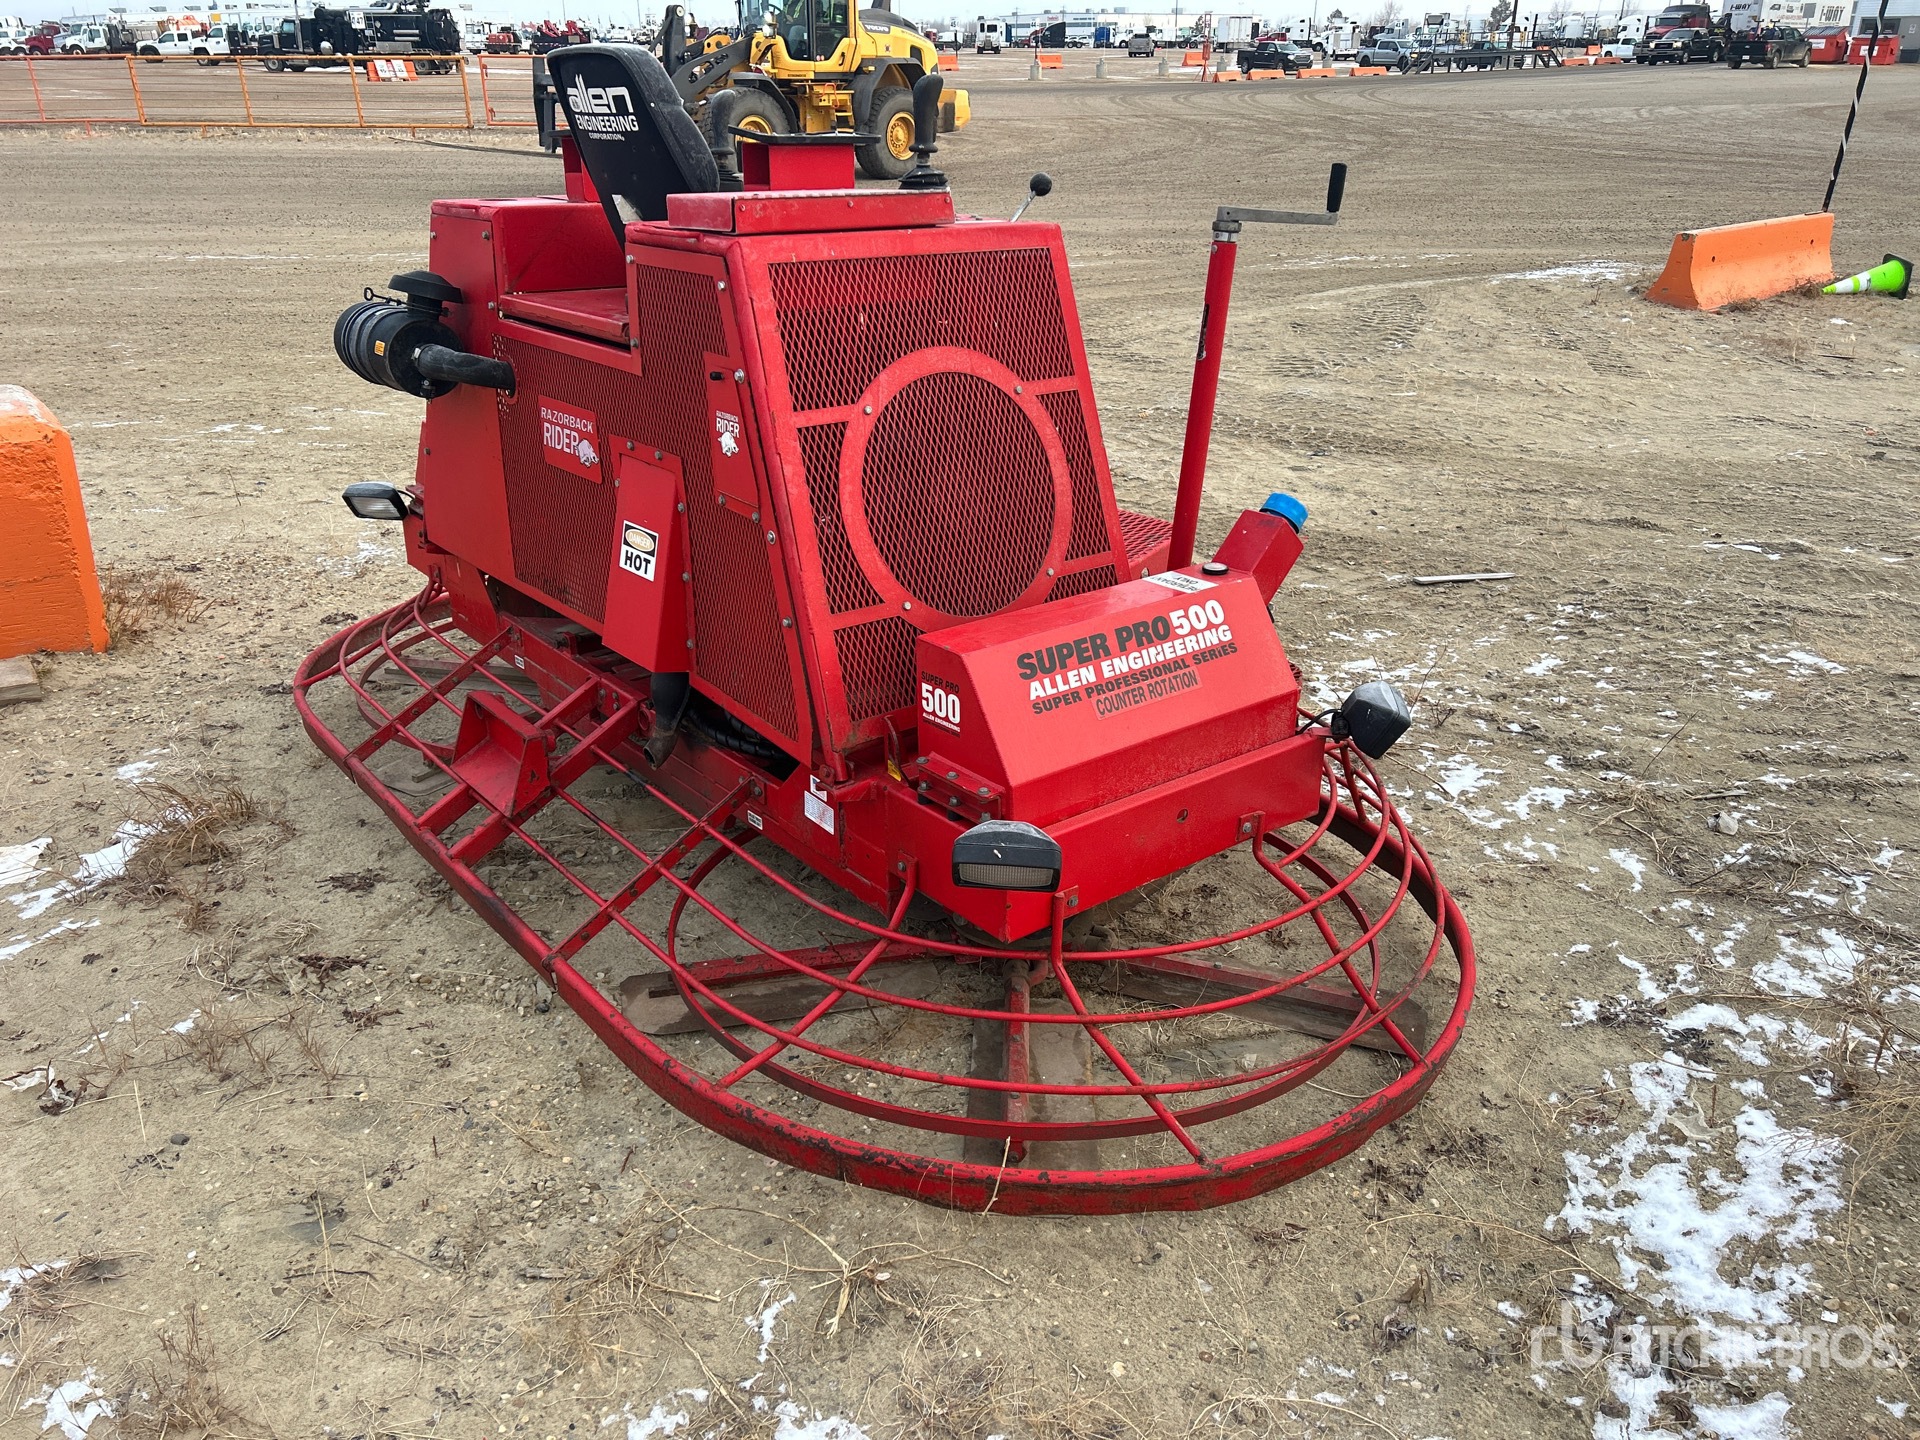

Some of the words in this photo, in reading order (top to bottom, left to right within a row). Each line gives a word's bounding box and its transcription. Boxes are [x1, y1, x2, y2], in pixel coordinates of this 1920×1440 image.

[864, 24, 889, 32] VOLVO
[566, 73, 634, 113] allen
[575, 114, 639, 132] ENGINEERING
[541, 407, 593, 434] RAZORBACK
[716, 418, 740, 438] RIDER
[543, 422, 579, 456] RIDER
[628, 532, 655, 549] DANGER
[624, 549, 651, 575] HOT
[1016, 632, 1111, 680] SUPER
[1115, 615, 1171, 652] PRO
[1169, 599, 1225, 636] 500
[1029, 665, 1097, 700] ALLEN
[1100, 624, 1233, 679] ENGINEERING
[921, 671, 943, 687] SUPER
[945, 680, 960, 694] PRO
[1032, 690, 1082, 715] SUPER
[1085, 658, 1190, 699] PROFESSIONAL
[1193, 642, 1238, 666] SERIES
[1095, 686, 1147, 716] COUNTER
[1149, 669, 1199, 703] ROTATION
[921, 682, 960, 724] 500
